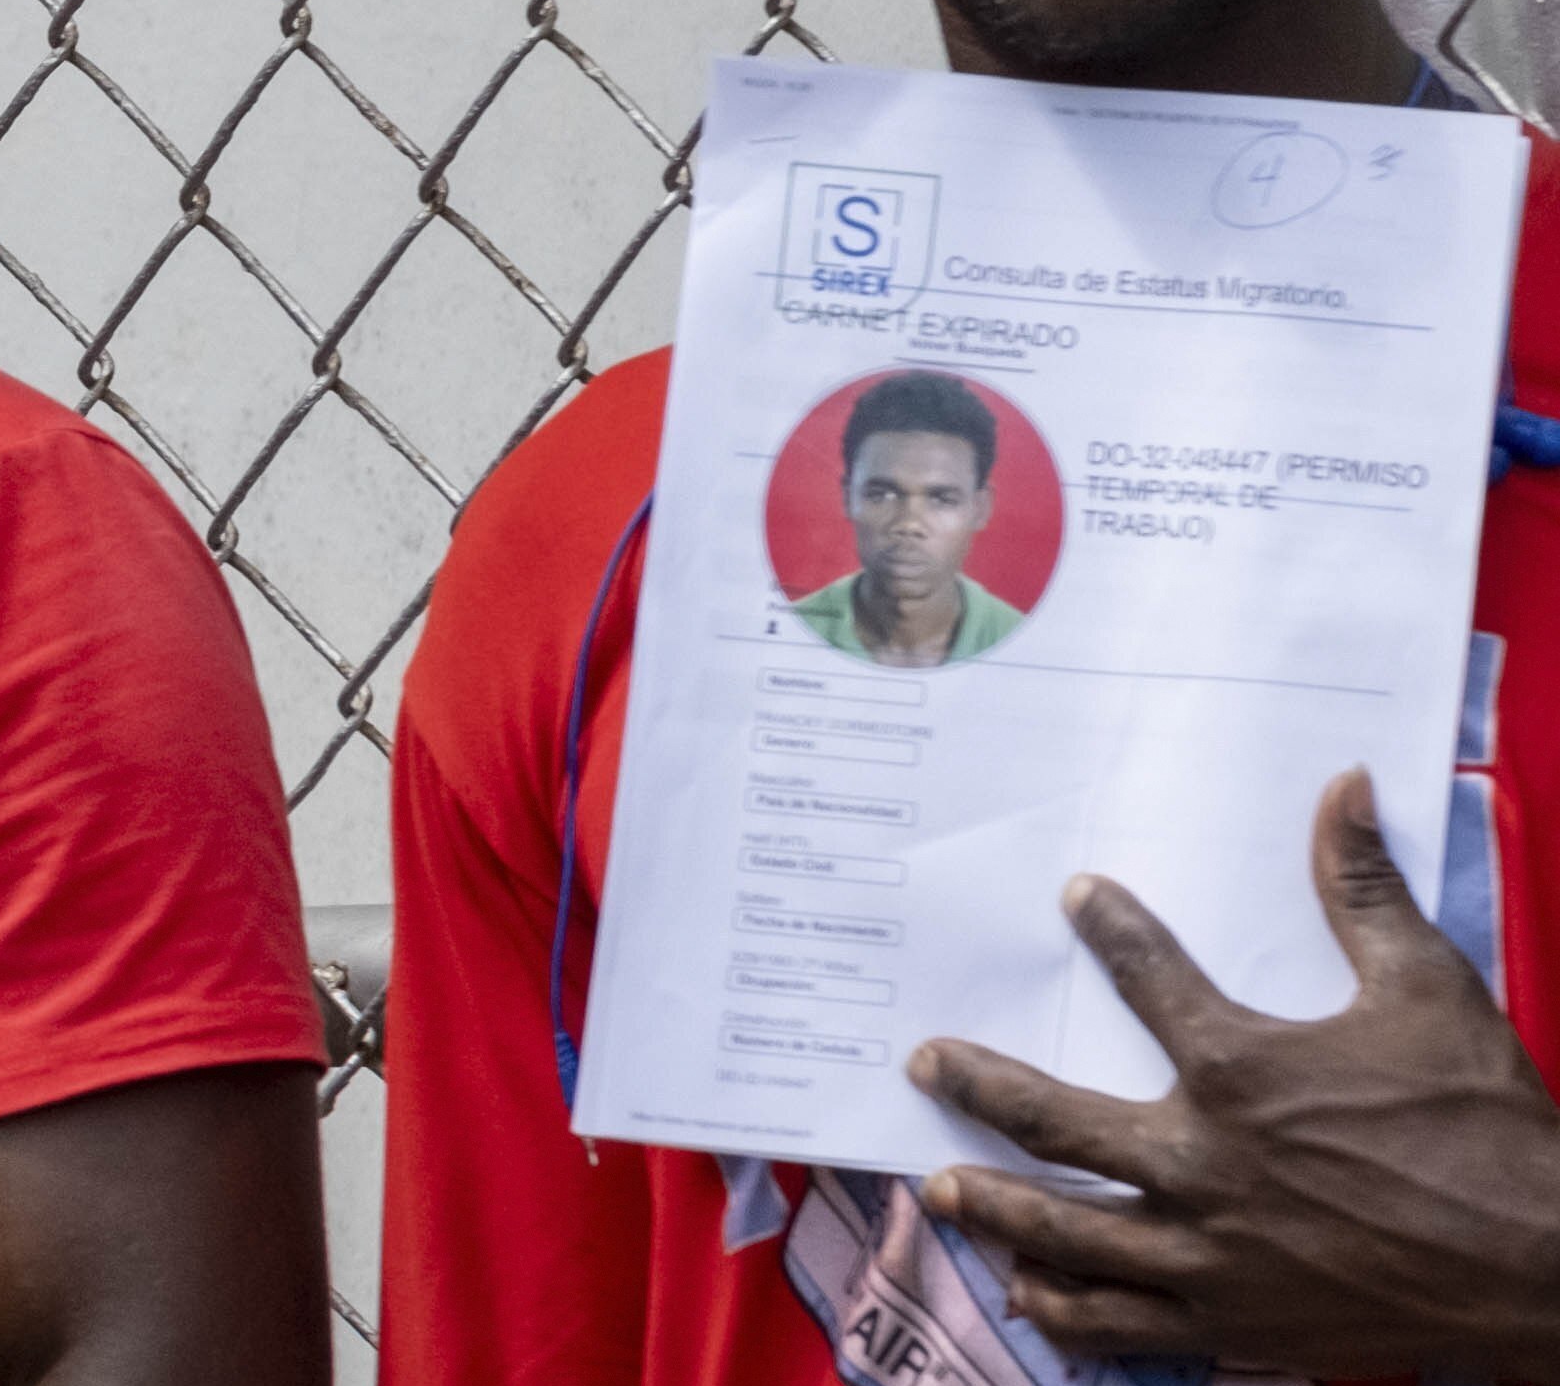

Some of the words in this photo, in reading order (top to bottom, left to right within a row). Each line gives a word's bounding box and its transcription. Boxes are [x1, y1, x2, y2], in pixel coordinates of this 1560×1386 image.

[1248, 155, 1286, 207] 4
[831, 195, 882, 258] S
[811, 267, 892, 298] SIREX
[943, 256, 1067, 290] Consulta
[1074, 271, 1108, 294] de
[1115, 270, 1209, 299] Estatus
[1216, 276, 1352, 309] Migratorio.
[782, 300, 909, 333] CARNET
[918, 313, 1080, 349] EXPIRADO
[1087, 475, 1231, 509] TEMPORAL
[1238, 484, 1280, 511] DE
[1275, 452, 1430, 491] (PERMISO
[1080, 508, 1216, 544] TRABAJO)
